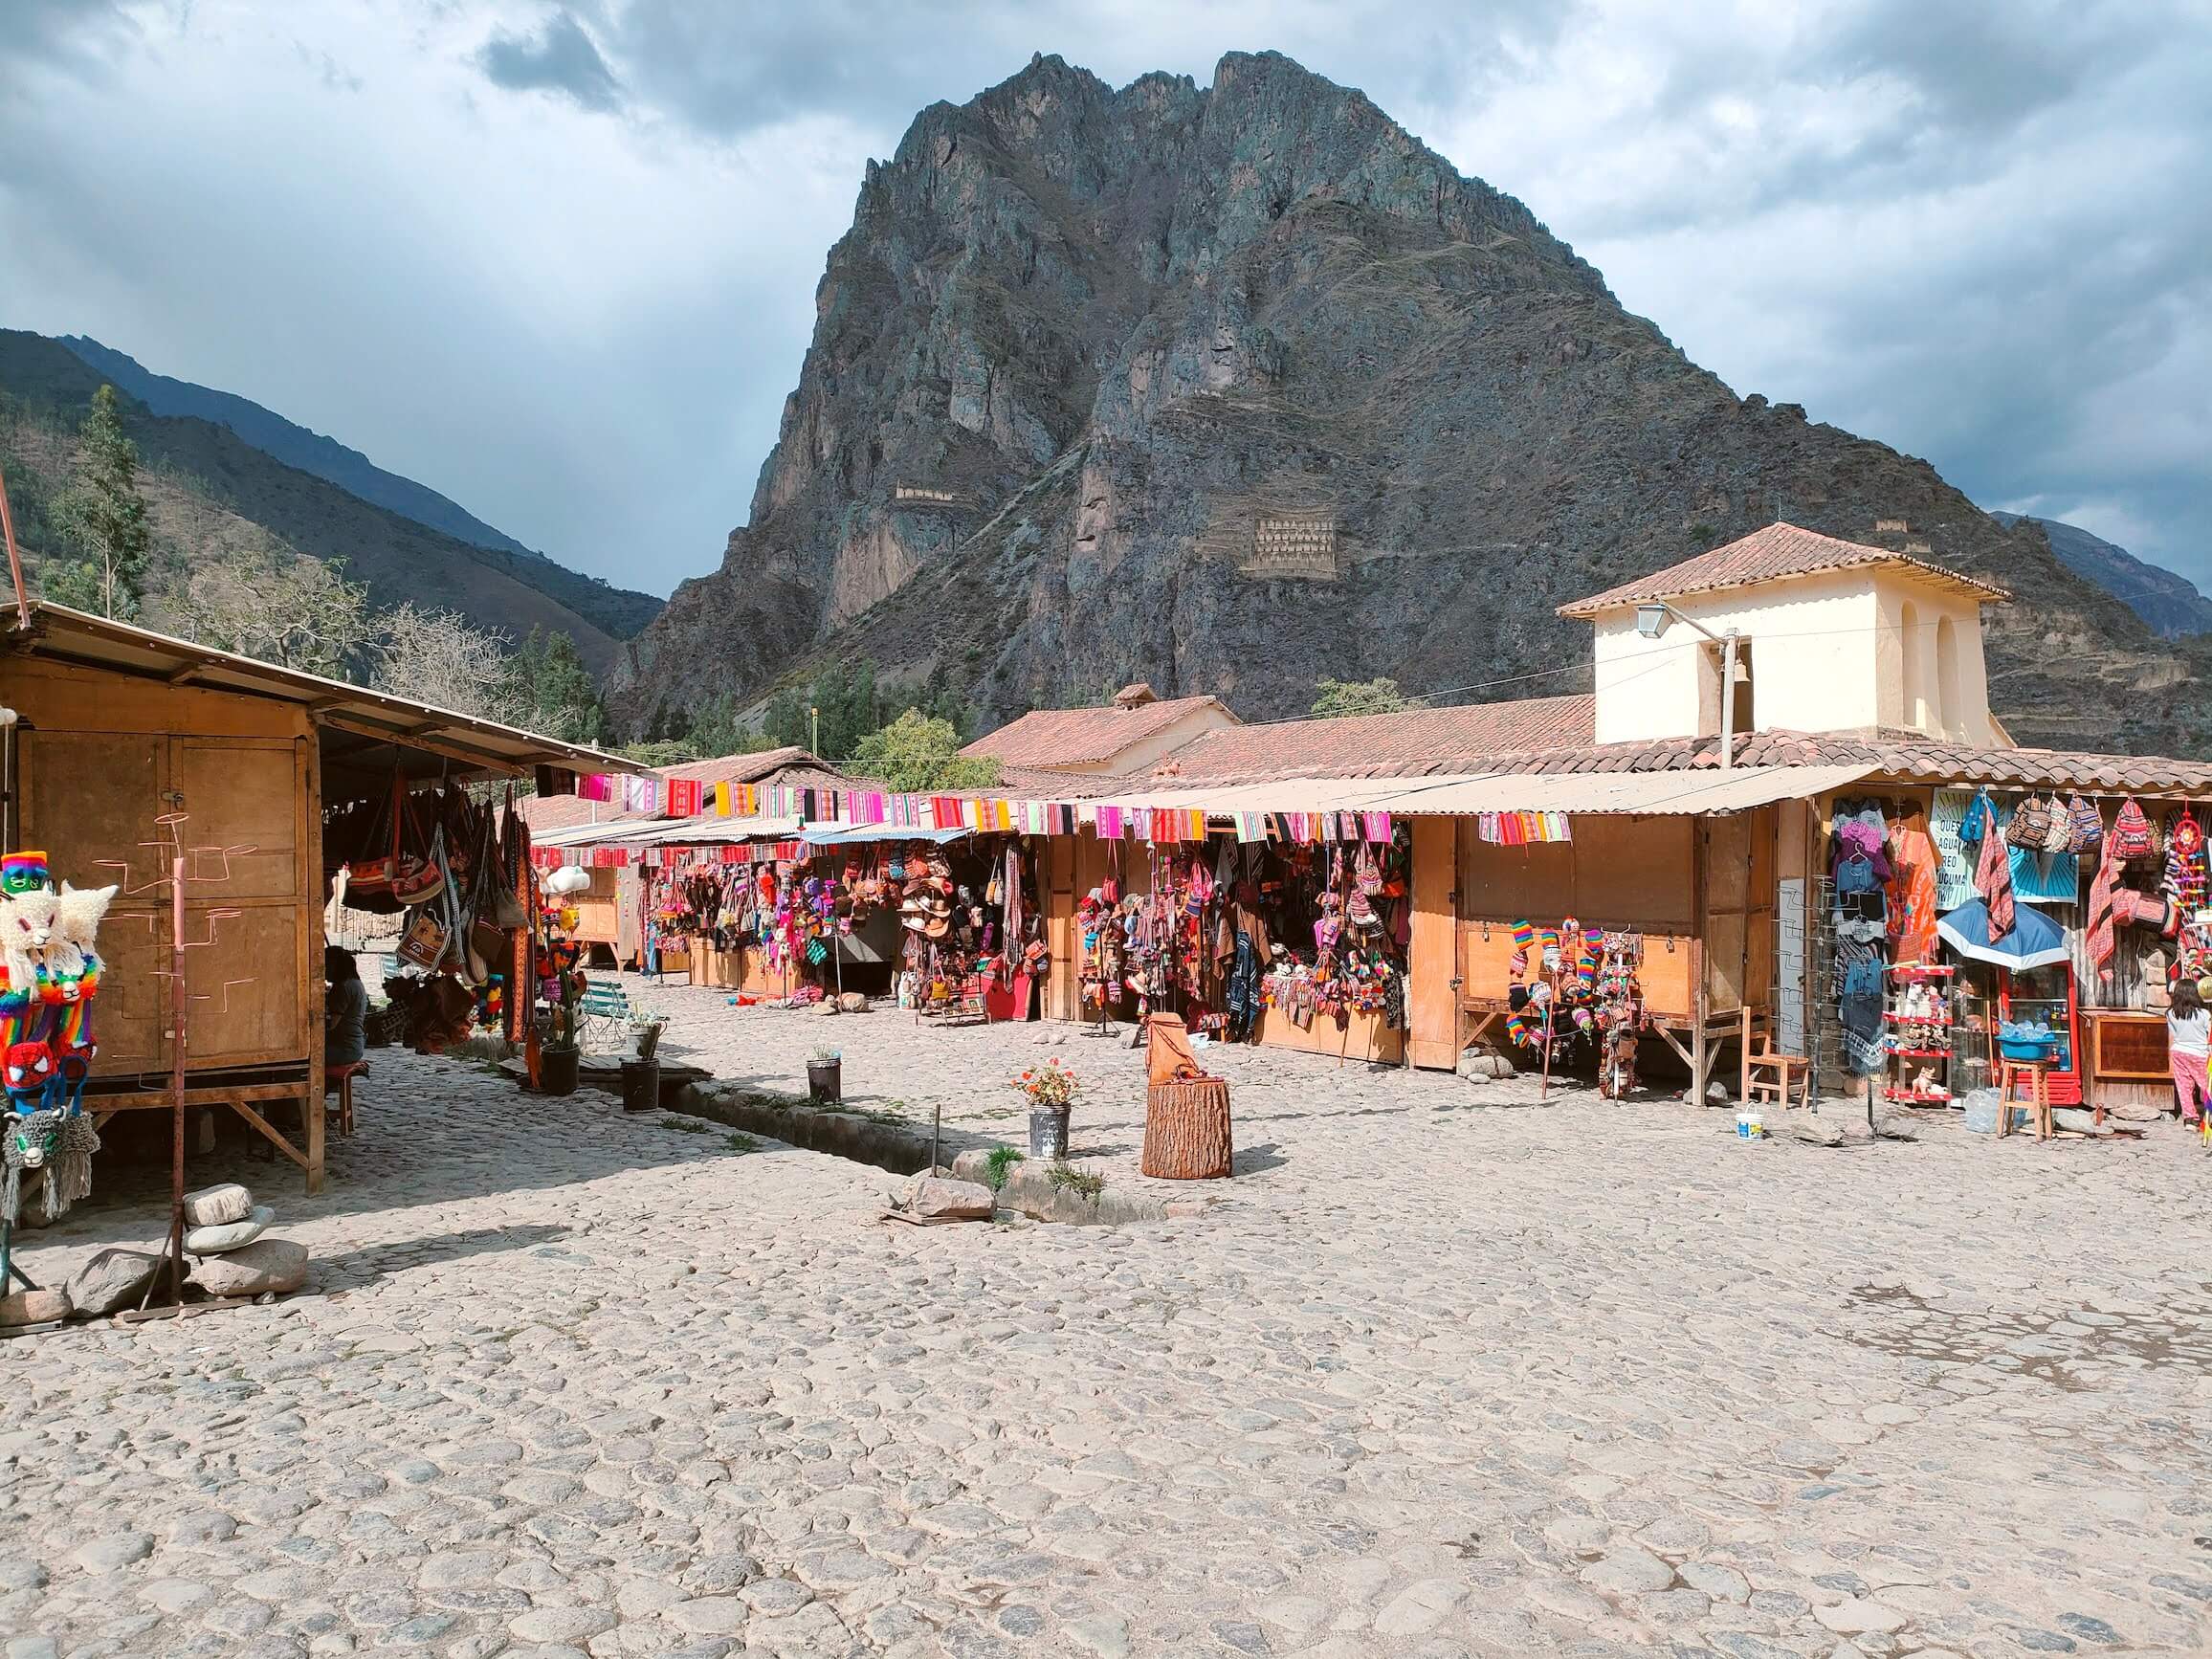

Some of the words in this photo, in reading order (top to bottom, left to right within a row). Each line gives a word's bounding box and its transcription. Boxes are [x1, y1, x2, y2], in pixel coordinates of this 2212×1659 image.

[1940, 819, 1959, 832] QUES
[1938, 837, 1958, 850] AGUA
[1941, 855, 1957, 868] REO
[1937, 872, 1965, 886] UCUMA
[1937, 890, 1949, 902] IWI
